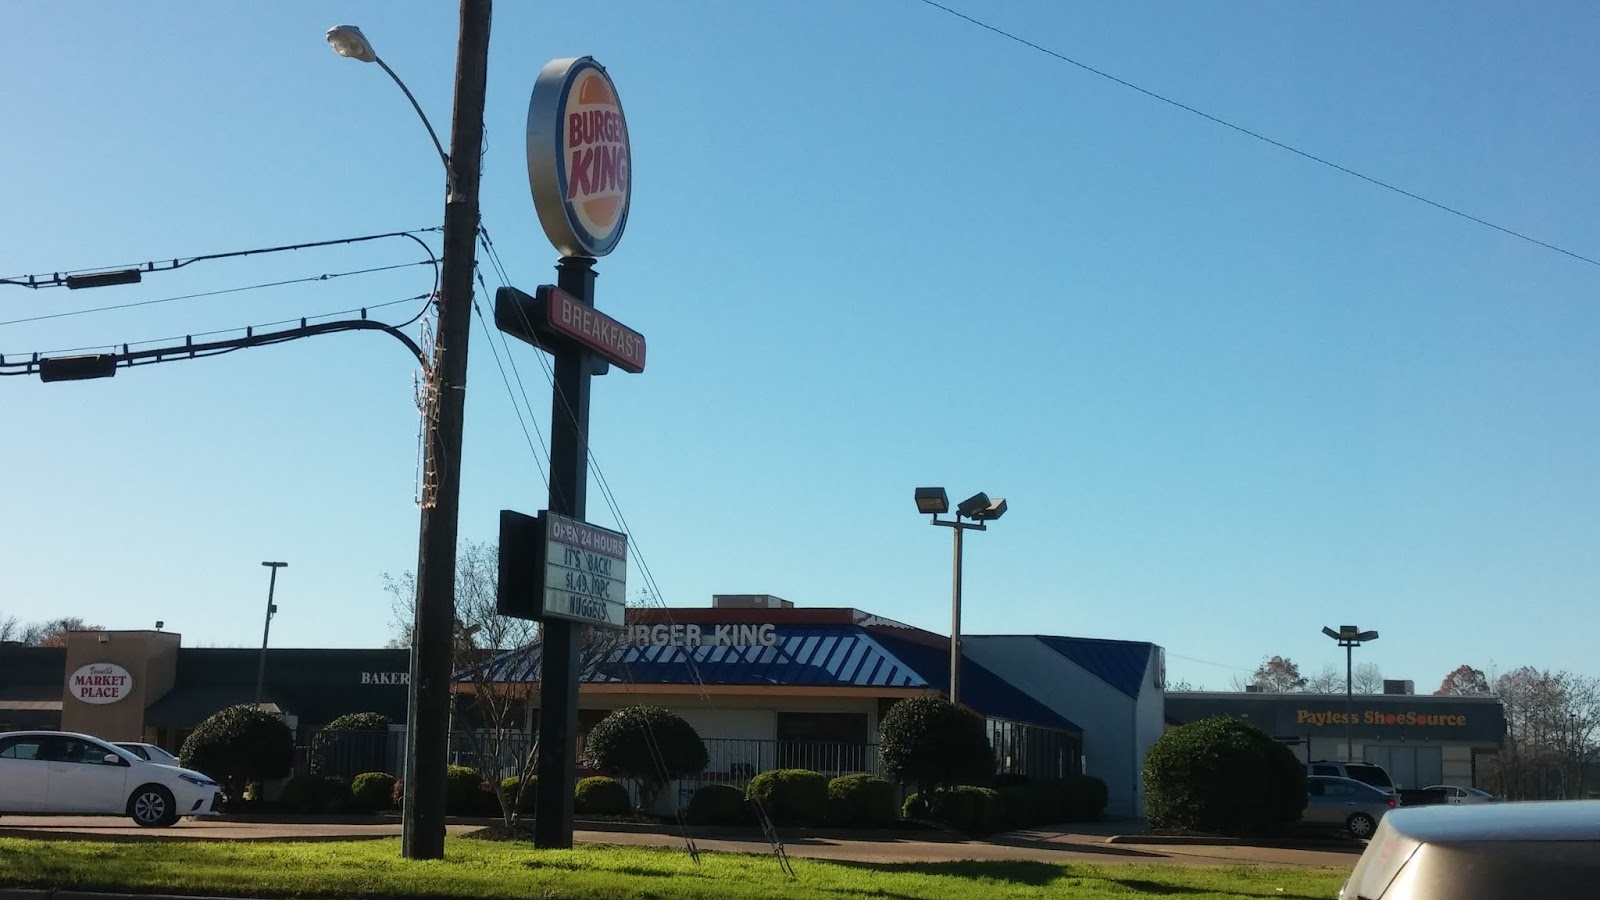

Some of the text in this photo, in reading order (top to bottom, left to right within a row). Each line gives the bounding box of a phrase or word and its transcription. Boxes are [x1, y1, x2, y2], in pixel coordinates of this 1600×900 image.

[569, 110, 626, 148] BURGER
[568, 145, 626, 199] KING
[562, 299, 641, 360] BREAKFAST
[553, 521, 623, 556] OPEN 24 HOURS
[588, 553, 612, 576] BACK!
[566, 571, 587, 592] $1.49
[570, 595, 607, 620] NUGGETS
[714, 623, 777, 646] KING
[75, 675, 126, 686] MARKET
[361, 671, 409, 685] BAKER
[80, 687, 119, 698] PLACE
[1297, 709, 1359, 726] Payless
